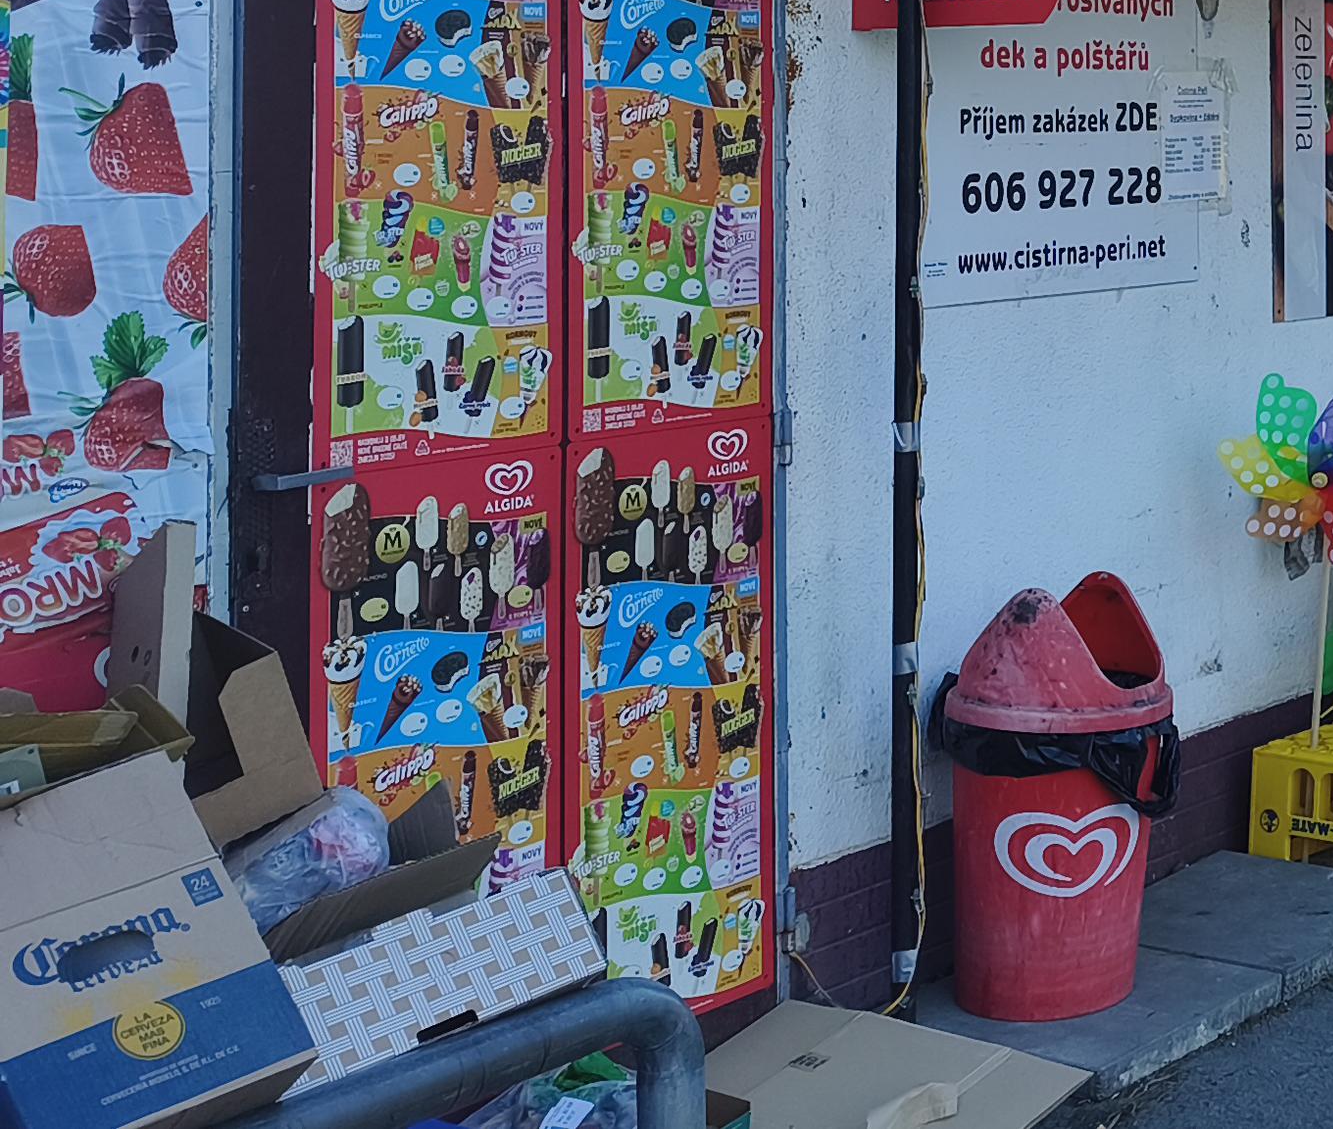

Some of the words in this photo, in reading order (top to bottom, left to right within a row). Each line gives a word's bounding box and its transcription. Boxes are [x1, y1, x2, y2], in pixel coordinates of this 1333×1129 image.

[980, 39, 1025, 70] dek
[1033, 49, 1047, 70] a
[1056, 40, 1150, 76] polštářů
[1294, 16, 1314, 153] zelenina
[379, 95, 439, 128] Calippo
[620, 96, 670, 126] Calippo
[959, 106, 1025, 141] Příjem
[1032, 107, 1109, 134] zakázek
[1115, 101, 1158, 132] ZDE
[500, 143, 542, 165] NOGGER
[721, 139, 757, 159] NOGGER
[962, 172, 1026, 214] 606
[1038, 169, 1095, 210] 927
[1107, 166, 1162, 205] 228
[957, 234, 1166, 275] www.cistirna-peri.net
[707, 461, 749, 477] ALGIDA
[484, 495, 535, 514] ALGIDA
[618, 586, 664, 629] Cornetto
[374, 635, 431, 683] Cornetto
[618, 686, 669, 728] Calippo
[721, 708, 755, 736] NOGGER
[374, 746, 435, 792] Calippo
[499, 767, 540, 800] NOGGER
[521, 847, 542, 861] NOVÝ
[190, 875, 211, 892] 24
[119, 1013, 175, 1040] CERVEZA
[134, 1012, 151, 1024] LA
[67, 1042, 97, 1061] SINCE
[141, 1036, 170, 1053] FINA
